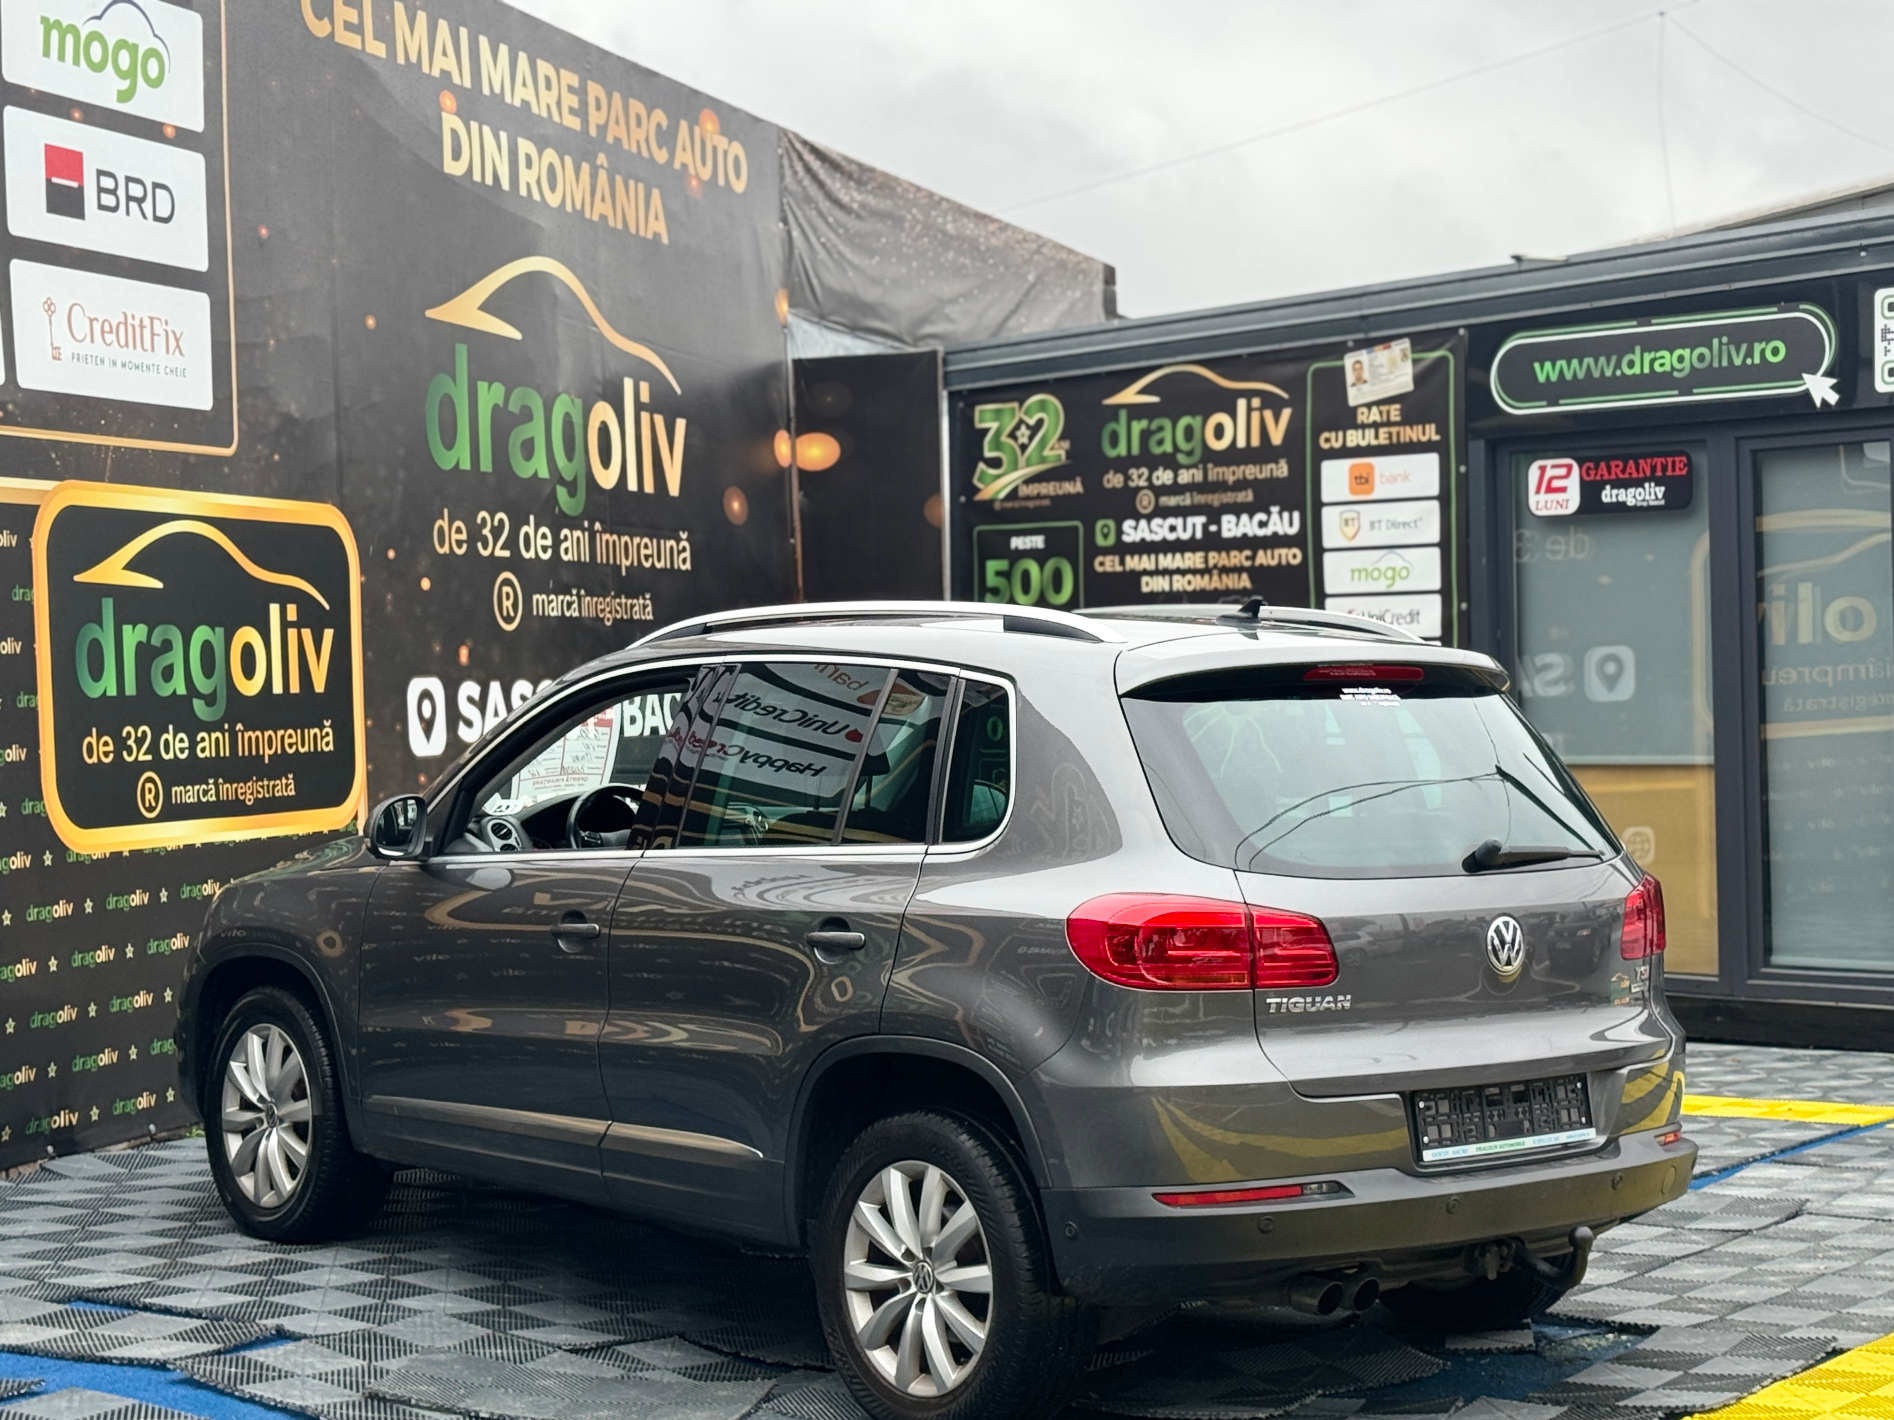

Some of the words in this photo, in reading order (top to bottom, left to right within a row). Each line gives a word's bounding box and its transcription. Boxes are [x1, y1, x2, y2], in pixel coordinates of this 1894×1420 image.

[40, 14, 166, 104] mogo
[301, 0, 387, 59] CEL
[394, 2, 472, 89] MAI
[478, 34, 581, 131] MARE
[586, 79, 669, 165] PARC
[673, 119, 748, 195] AUTO
[96, 168, 175, 225] BRD
[441, 111, 510, 191] DIN
[517, 136, 669, 246] ROMÂNIA
[67, 302, 185, 357] CreditFix
[71, 352, 105, 367] PRIETEN
[108, 358, 117, 368] IN
[121, 360, 160, 374] MOMENTE
[164, 366, 187, 378] CHEIE
[1533, 335, 1787, 384] www.dragoliv.ro
[425, 342, 687, 517] dragoliv
[1101, 397, 1293, 466] dragoliv
[1356, 404, 1401, 425] RATE
[973, 393, 1065, 489] 32
[1319, 430, 1343, 449] CU
[1345, 423, 1440, 447] BULETINUL
[1103, 469, 1125, 489] de
[1127, 467, 1149, 487] 32
[1152, 466, 1174, 486] de
[1177, 463, 1204, 485] ani
[1207, 458, 1289, 485] împreună
[1379, 470, 1411, 485] bank
[1534, 463, 1573, 495] 12
[1581, 456, 1689, 481] GARANTIE
[1535, 499, 1570, 511] LUNI
[1601, 482, 1666, 506] dragoliv
[433, 508, 468, 556] de
[477, 510, 511, 558] 32
[519, 514, 552, 561] de
[560, 520, 590, 563] ani
[594, 521, 692, 577] împreună
[1010, 535, 1045, 550] PESTE
[1121, 515, 1207, 543] SASCUT
[1221, 505, 1301, 538] BACĂU
[1093, 555, 1123, 573] CEL
[1125, 553, 1157, 571] MAI
[1158, 551, 1206, 570] MARE
[1208, 549, 1253, 569] PARC
[1254, 547, 1303, 566] AUTO
[1350, 566, 1410, 589] mogo
[984, 556, 1074, 606] 500
[1140, 575, 1171, 593] DIN
[1172, 569, 1252, 592] ROMÂNIA
[532, 588, 580, 618] marcă
[581, 589, 653, 626] înregistrată
[75, 597, 334, 722] dragoliv
[82, 727, 114, 765] de
[121, 725, 153, 763] 32
[159, 724, 190, 760] de
[196, 723, 230, 758] ani
[235, 719, 335, 764] împreună
[171, 778, 217, 804] marcă
[218, 773, 296, 806] înregistrată
[26, 899, 73, 923] dragoliv
[106, 889, 150, 912] dragoliv
[180, 879, 220, 900] dragoliv
[71, 945, 115, 968] dragoliv
[146, 932, 190, 955] dragoliv
[30, 1004, 78, 1029] dragoliv
[109, 989, 154, 1013] dragoliv
[1266, 994, 1351, 1014] TIGUAN
[72, 1048, 119, 1072] dragoliv
[25, 1109, 79, 1135] dragoliv
[112, 1091, 157, 1115] dragoliv
